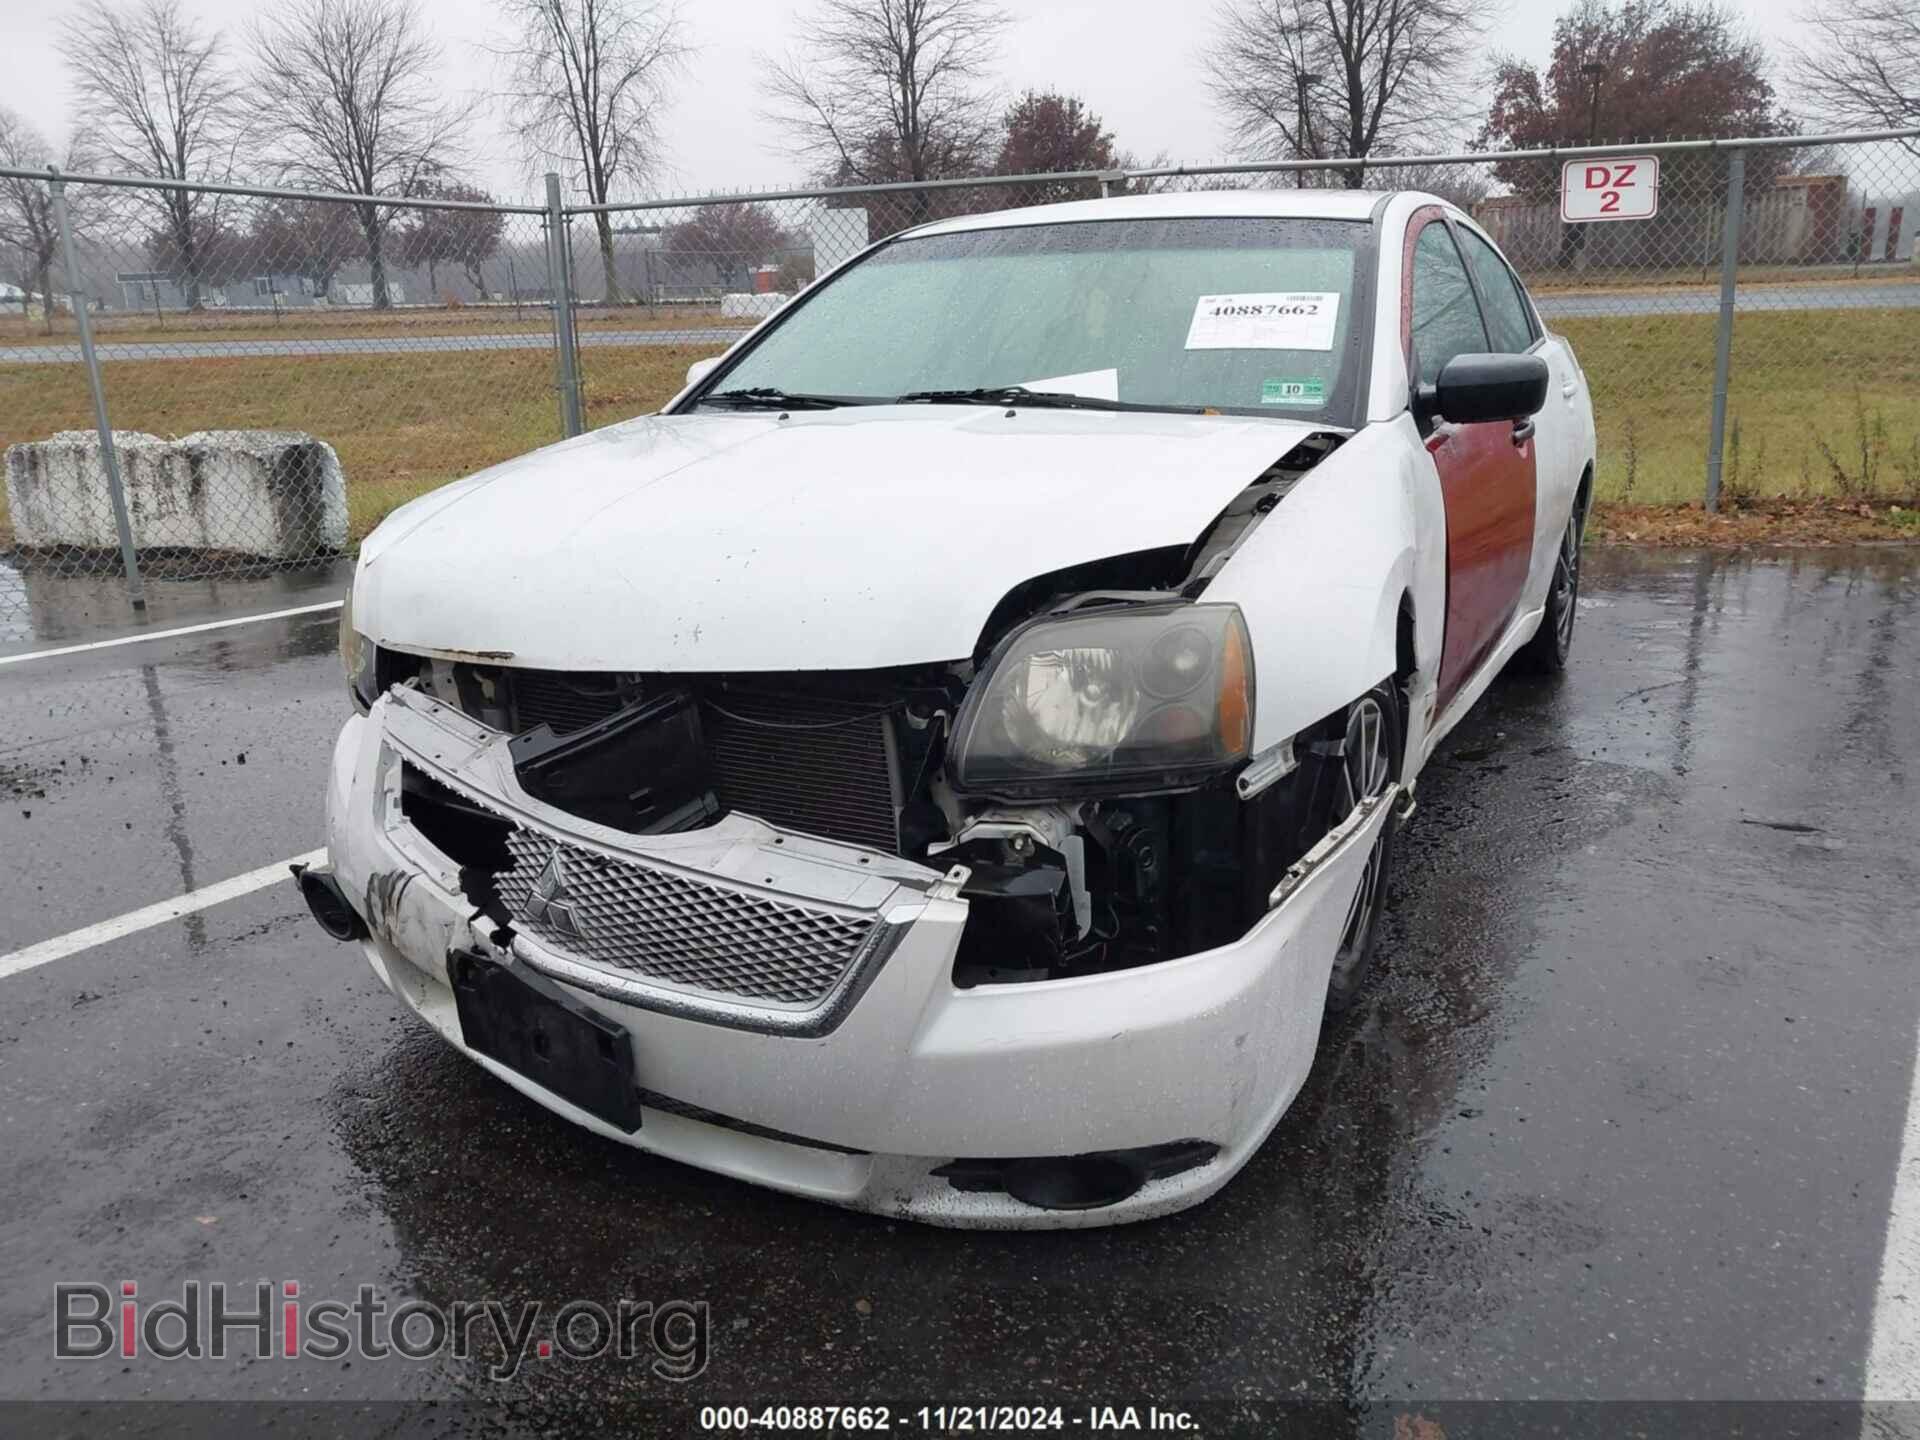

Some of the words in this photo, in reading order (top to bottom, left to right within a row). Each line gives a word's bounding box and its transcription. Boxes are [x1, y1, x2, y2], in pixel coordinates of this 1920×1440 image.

[1585, 165, 1637, 189] DZ
[1600, 191, 1620, 213] 2
[1209, 304, 1319, 317] 40887662
[1286, 384, 1301, 395] 10
